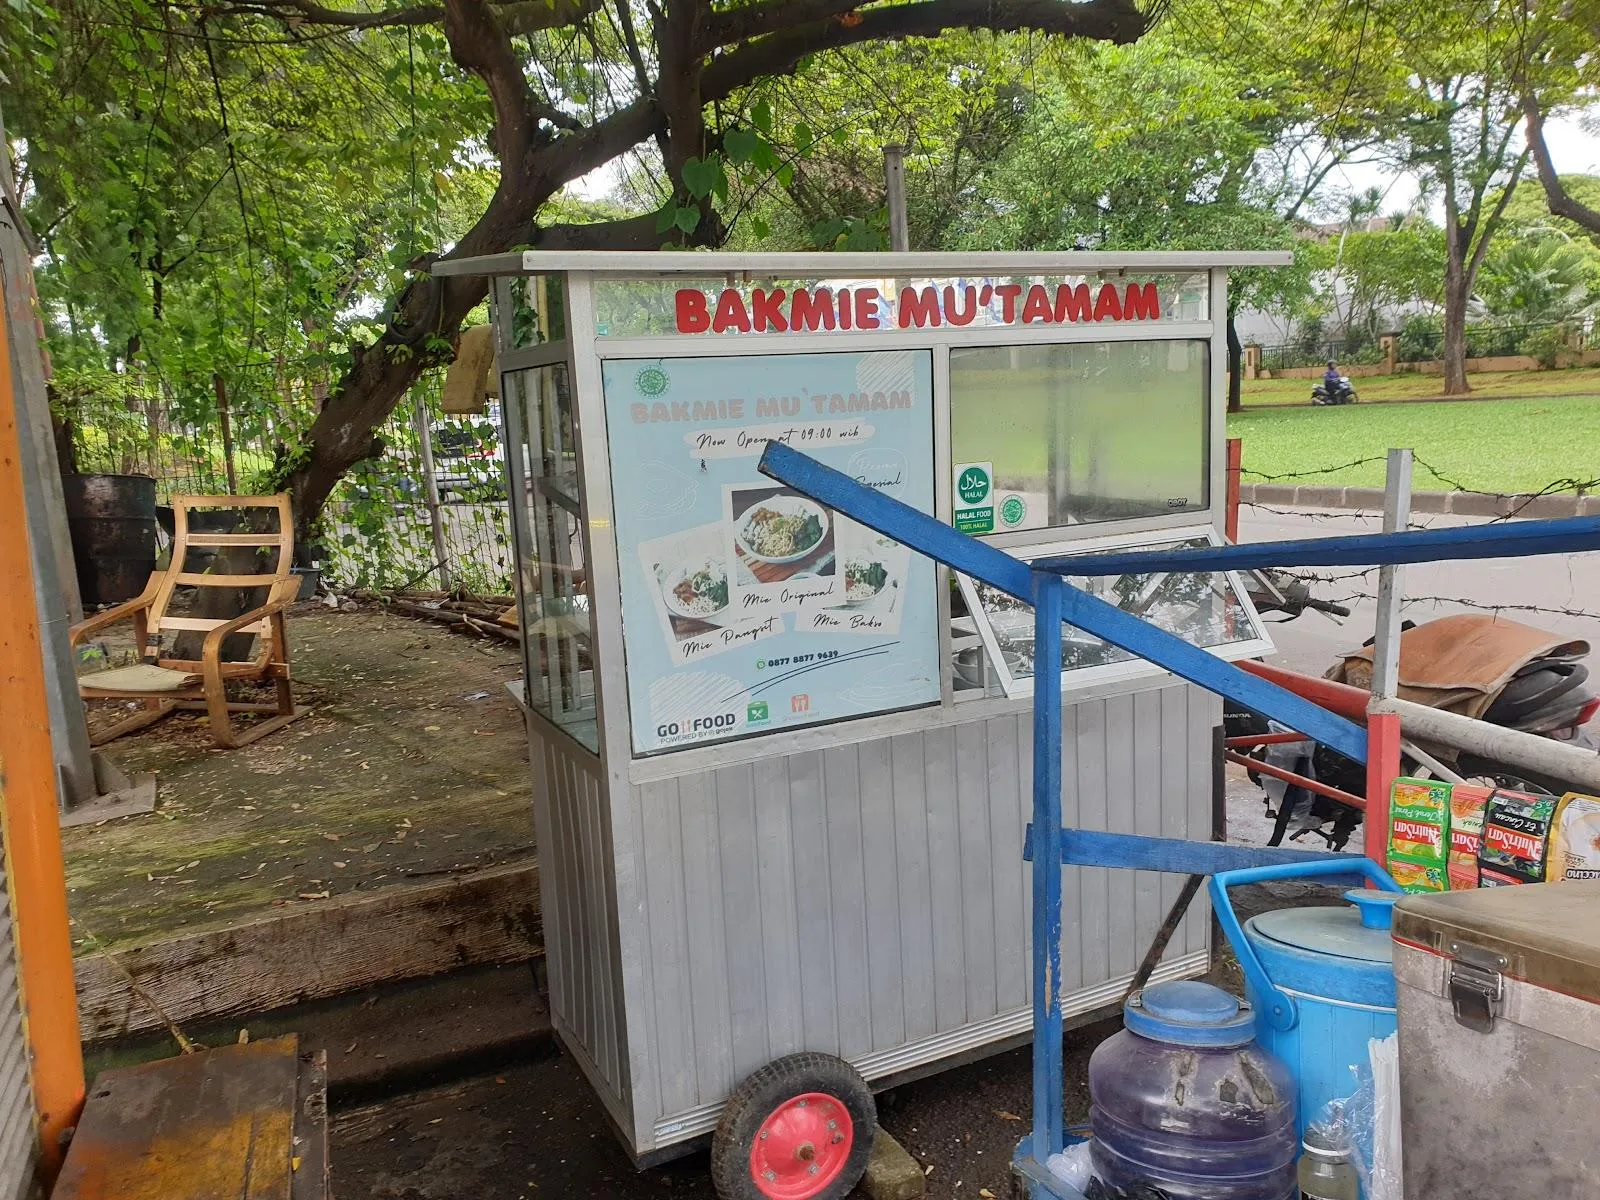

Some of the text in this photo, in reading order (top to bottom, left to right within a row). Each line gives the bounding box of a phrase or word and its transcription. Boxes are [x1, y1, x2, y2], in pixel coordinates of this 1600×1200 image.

[675, 288, 880, 333] BAKMIE
[630, 399, 744, 424] BAKMIE
[697, 433, 726, 449] Now
[801, 427, 832, 440] 09:00
[964, 491, 983, 499] HALAL
[956, 510, 992, 520] HALAL FOOD
[780, 581, 834, 606] Original
[720, 616, 780, 645] Pangsit
[849, 615, 882, 629] Bakso
[768, 657, 790, 667] 0877
[793, 654, 814, 664] 8877
[693, 713, 736, 731] FOOD
